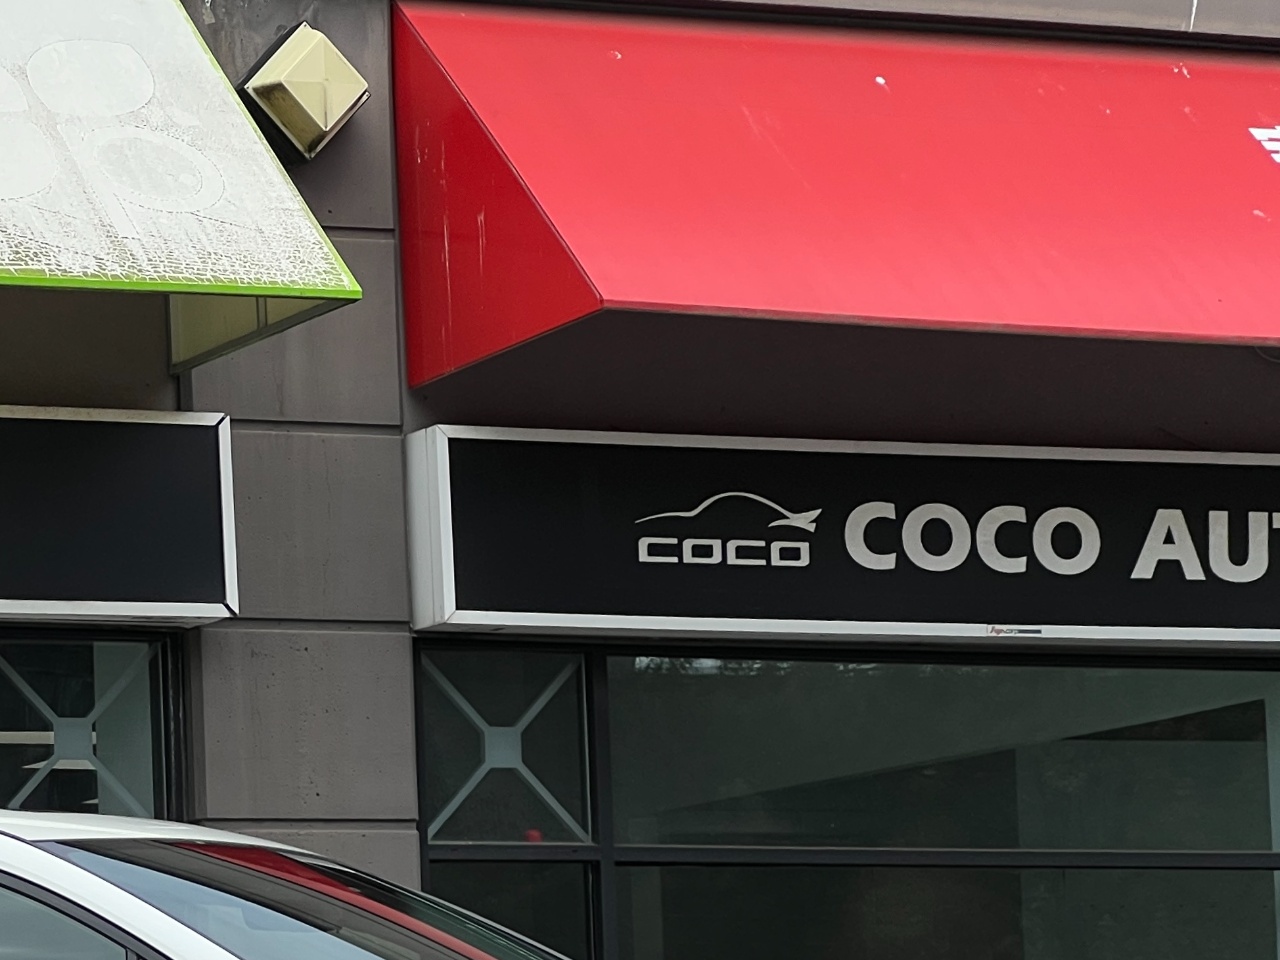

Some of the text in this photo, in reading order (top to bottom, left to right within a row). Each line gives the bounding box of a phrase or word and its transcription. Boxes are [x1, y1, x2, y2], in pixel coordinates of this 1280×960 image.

[638, 536, 810, 567] COCO
[844, 501, 1280, 583] COCO AU
